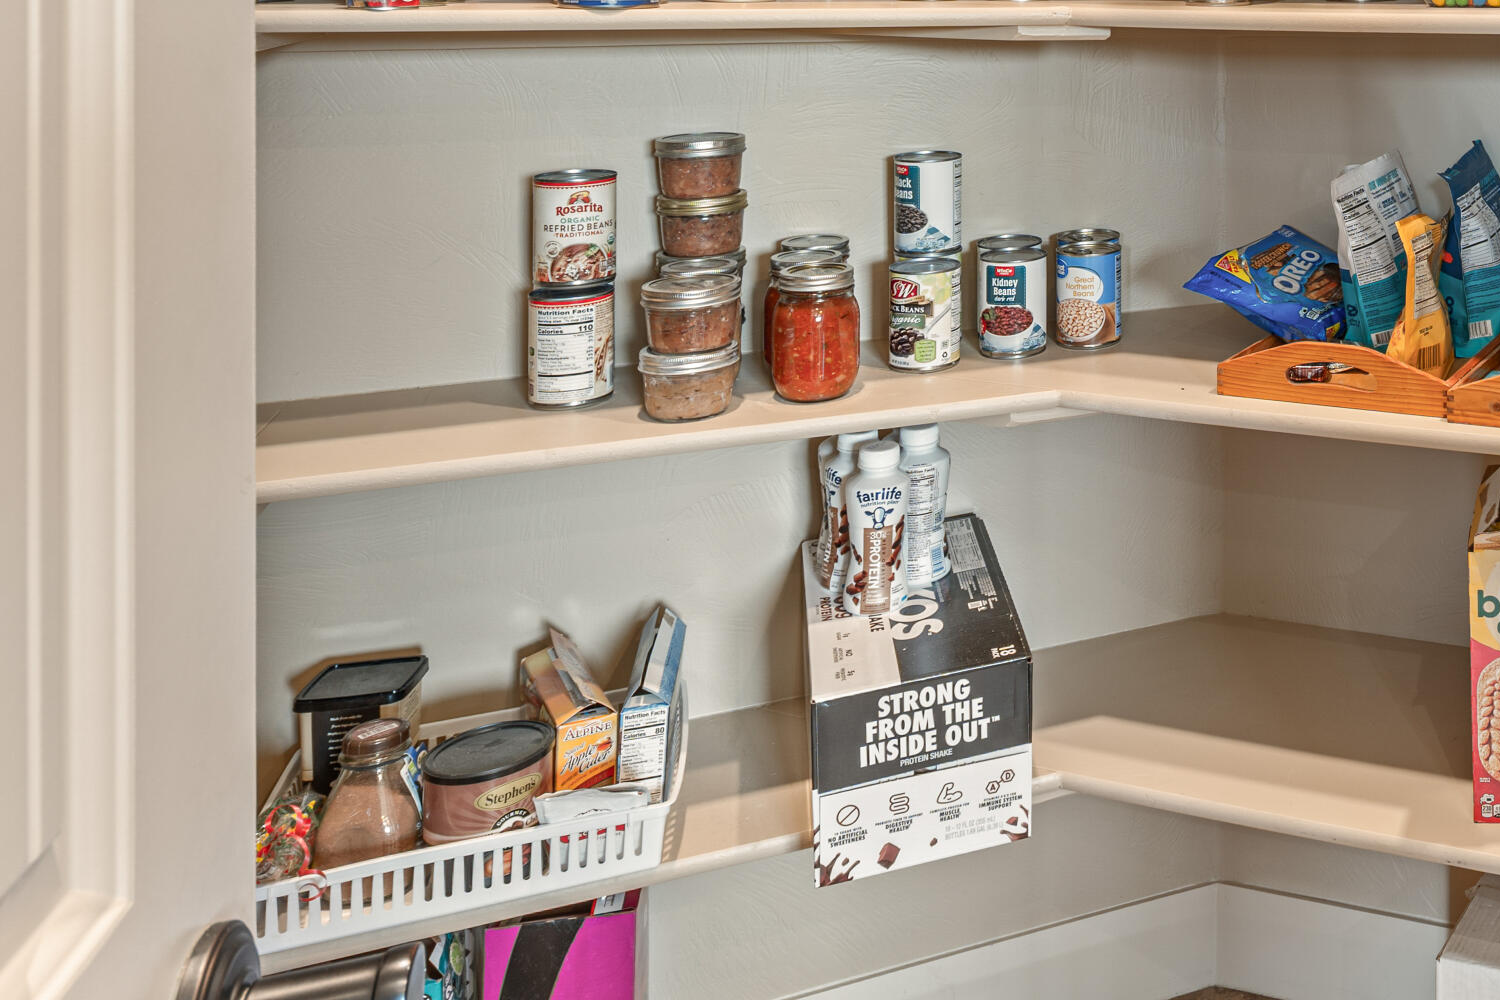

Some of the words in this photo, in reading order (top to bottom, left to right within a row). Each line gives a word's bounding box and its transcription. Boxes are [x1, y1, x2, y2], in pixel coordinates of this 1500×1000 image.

[556, 203, 603, 216] Rosarita
[544, 223, 584, 232] REFRIED
[586, 219, 614, 230] BEANS
[560, 216, 600, 224] ORGANIC
[554, 230, 604, 238] TRADITIONAL
[1272, 250, 1322, 295] OREO
[992, 278, 1018, 288] Kidney
[993, 286, 1016, 296] Beans
[578, 324, 593, 332] 110
[867, 540, 880, 589] PROTEIN
[820, 596, 832, 622] PROTEIN
[878, 678, 971, 718] STRONG
[624, 712, 650, 720] Nutrition
[865, 707, 936, 744] FROM
[942, 697, 984, 726] THE
[564, 722, 612, 742] ALPINE
[623, 732, 646, 740] Calories
[654, 727, 665, 735] 80
[859, 728, 938, 768] INSIDE
[578, 750, 612, 774] Cider
[900, 752, 929, 767] PROTEIN
[930, 748, 953, 762] SHAKE
[485, 777, 536, 807] Stephen's
[978, 798, 1000, 808] IMMUNE
[1000, 795, 1023, 804] SYSTEM
[988, 802, 1012, 812] SUPPORT
[939, 808, 960, 817] MUSCLE
[884, 819, 914, 830] DIGESTIVE
[830, 836, 866, 848] SWEETENERS
[838, 830, 868, 841] ARTIFICIAL
